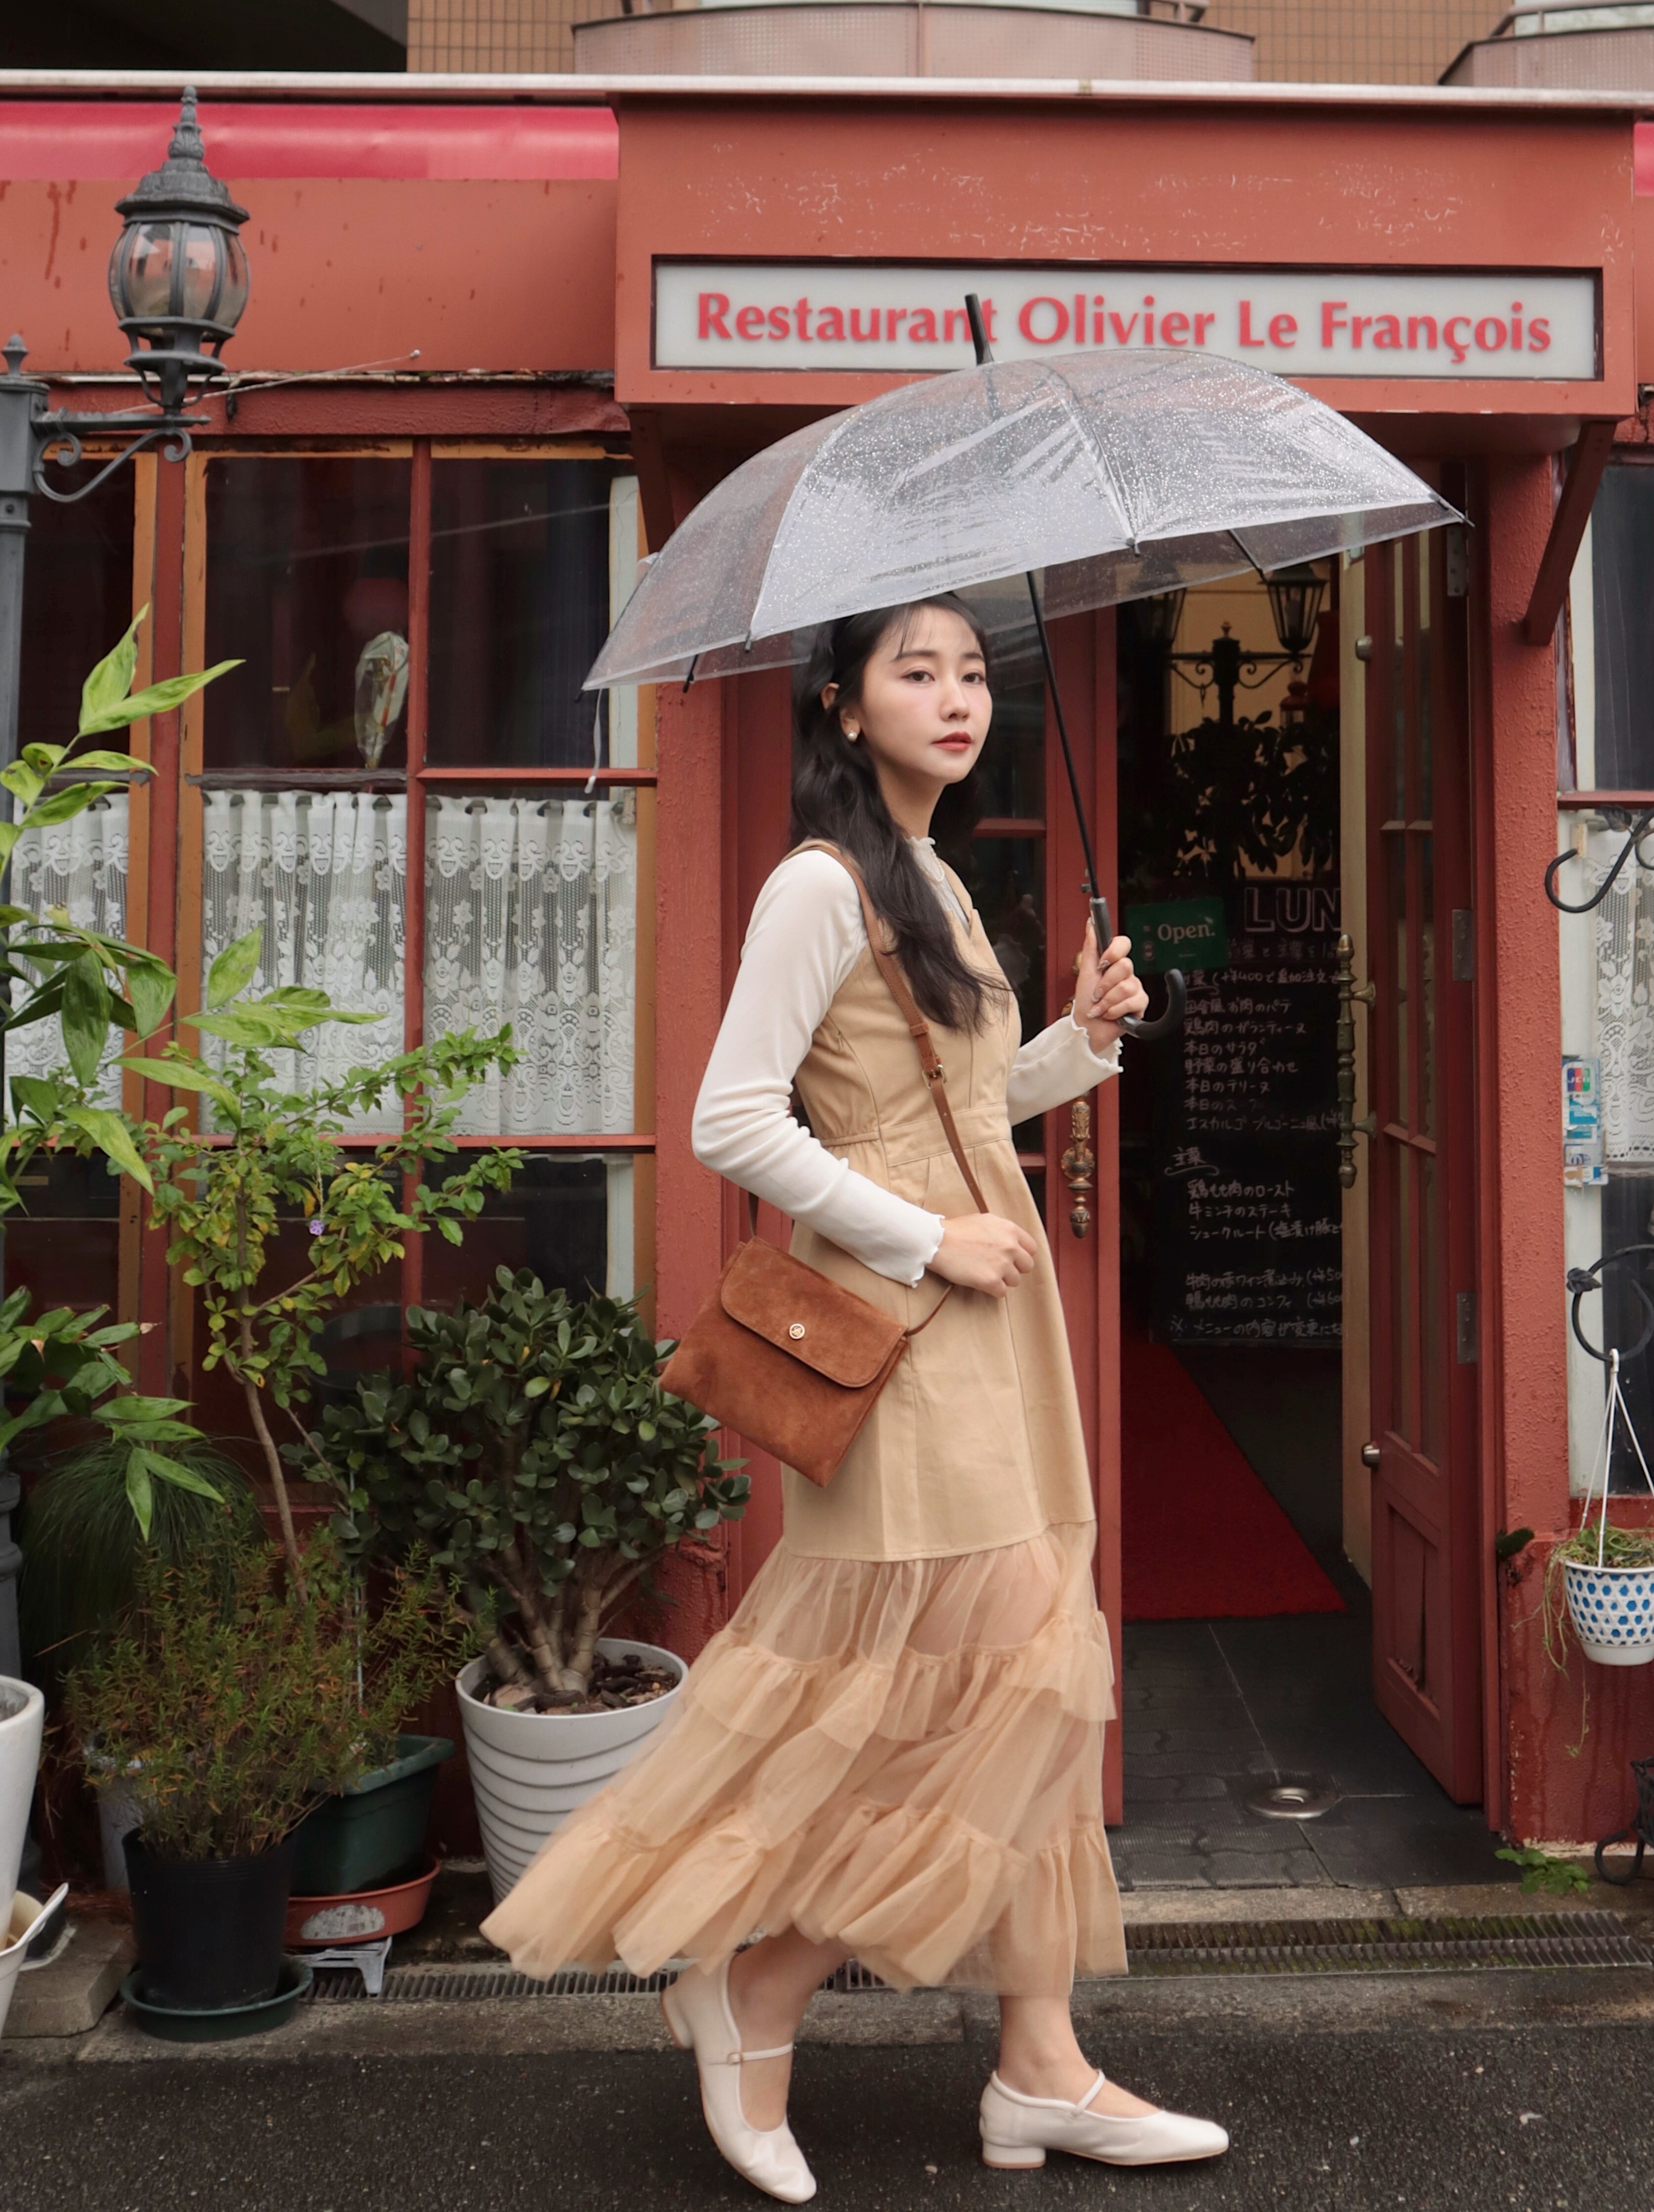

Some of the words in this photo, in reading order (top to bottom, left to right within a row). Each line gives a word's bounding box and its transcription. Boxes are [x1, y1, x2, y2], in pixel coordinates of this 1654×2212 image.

[697, 293, 997, 342] Restaurant
[1018, 294, 1215, 345] Olivier
[1239, 301, 1298, 347] Le
[1321, 302, 1551, 363] François
